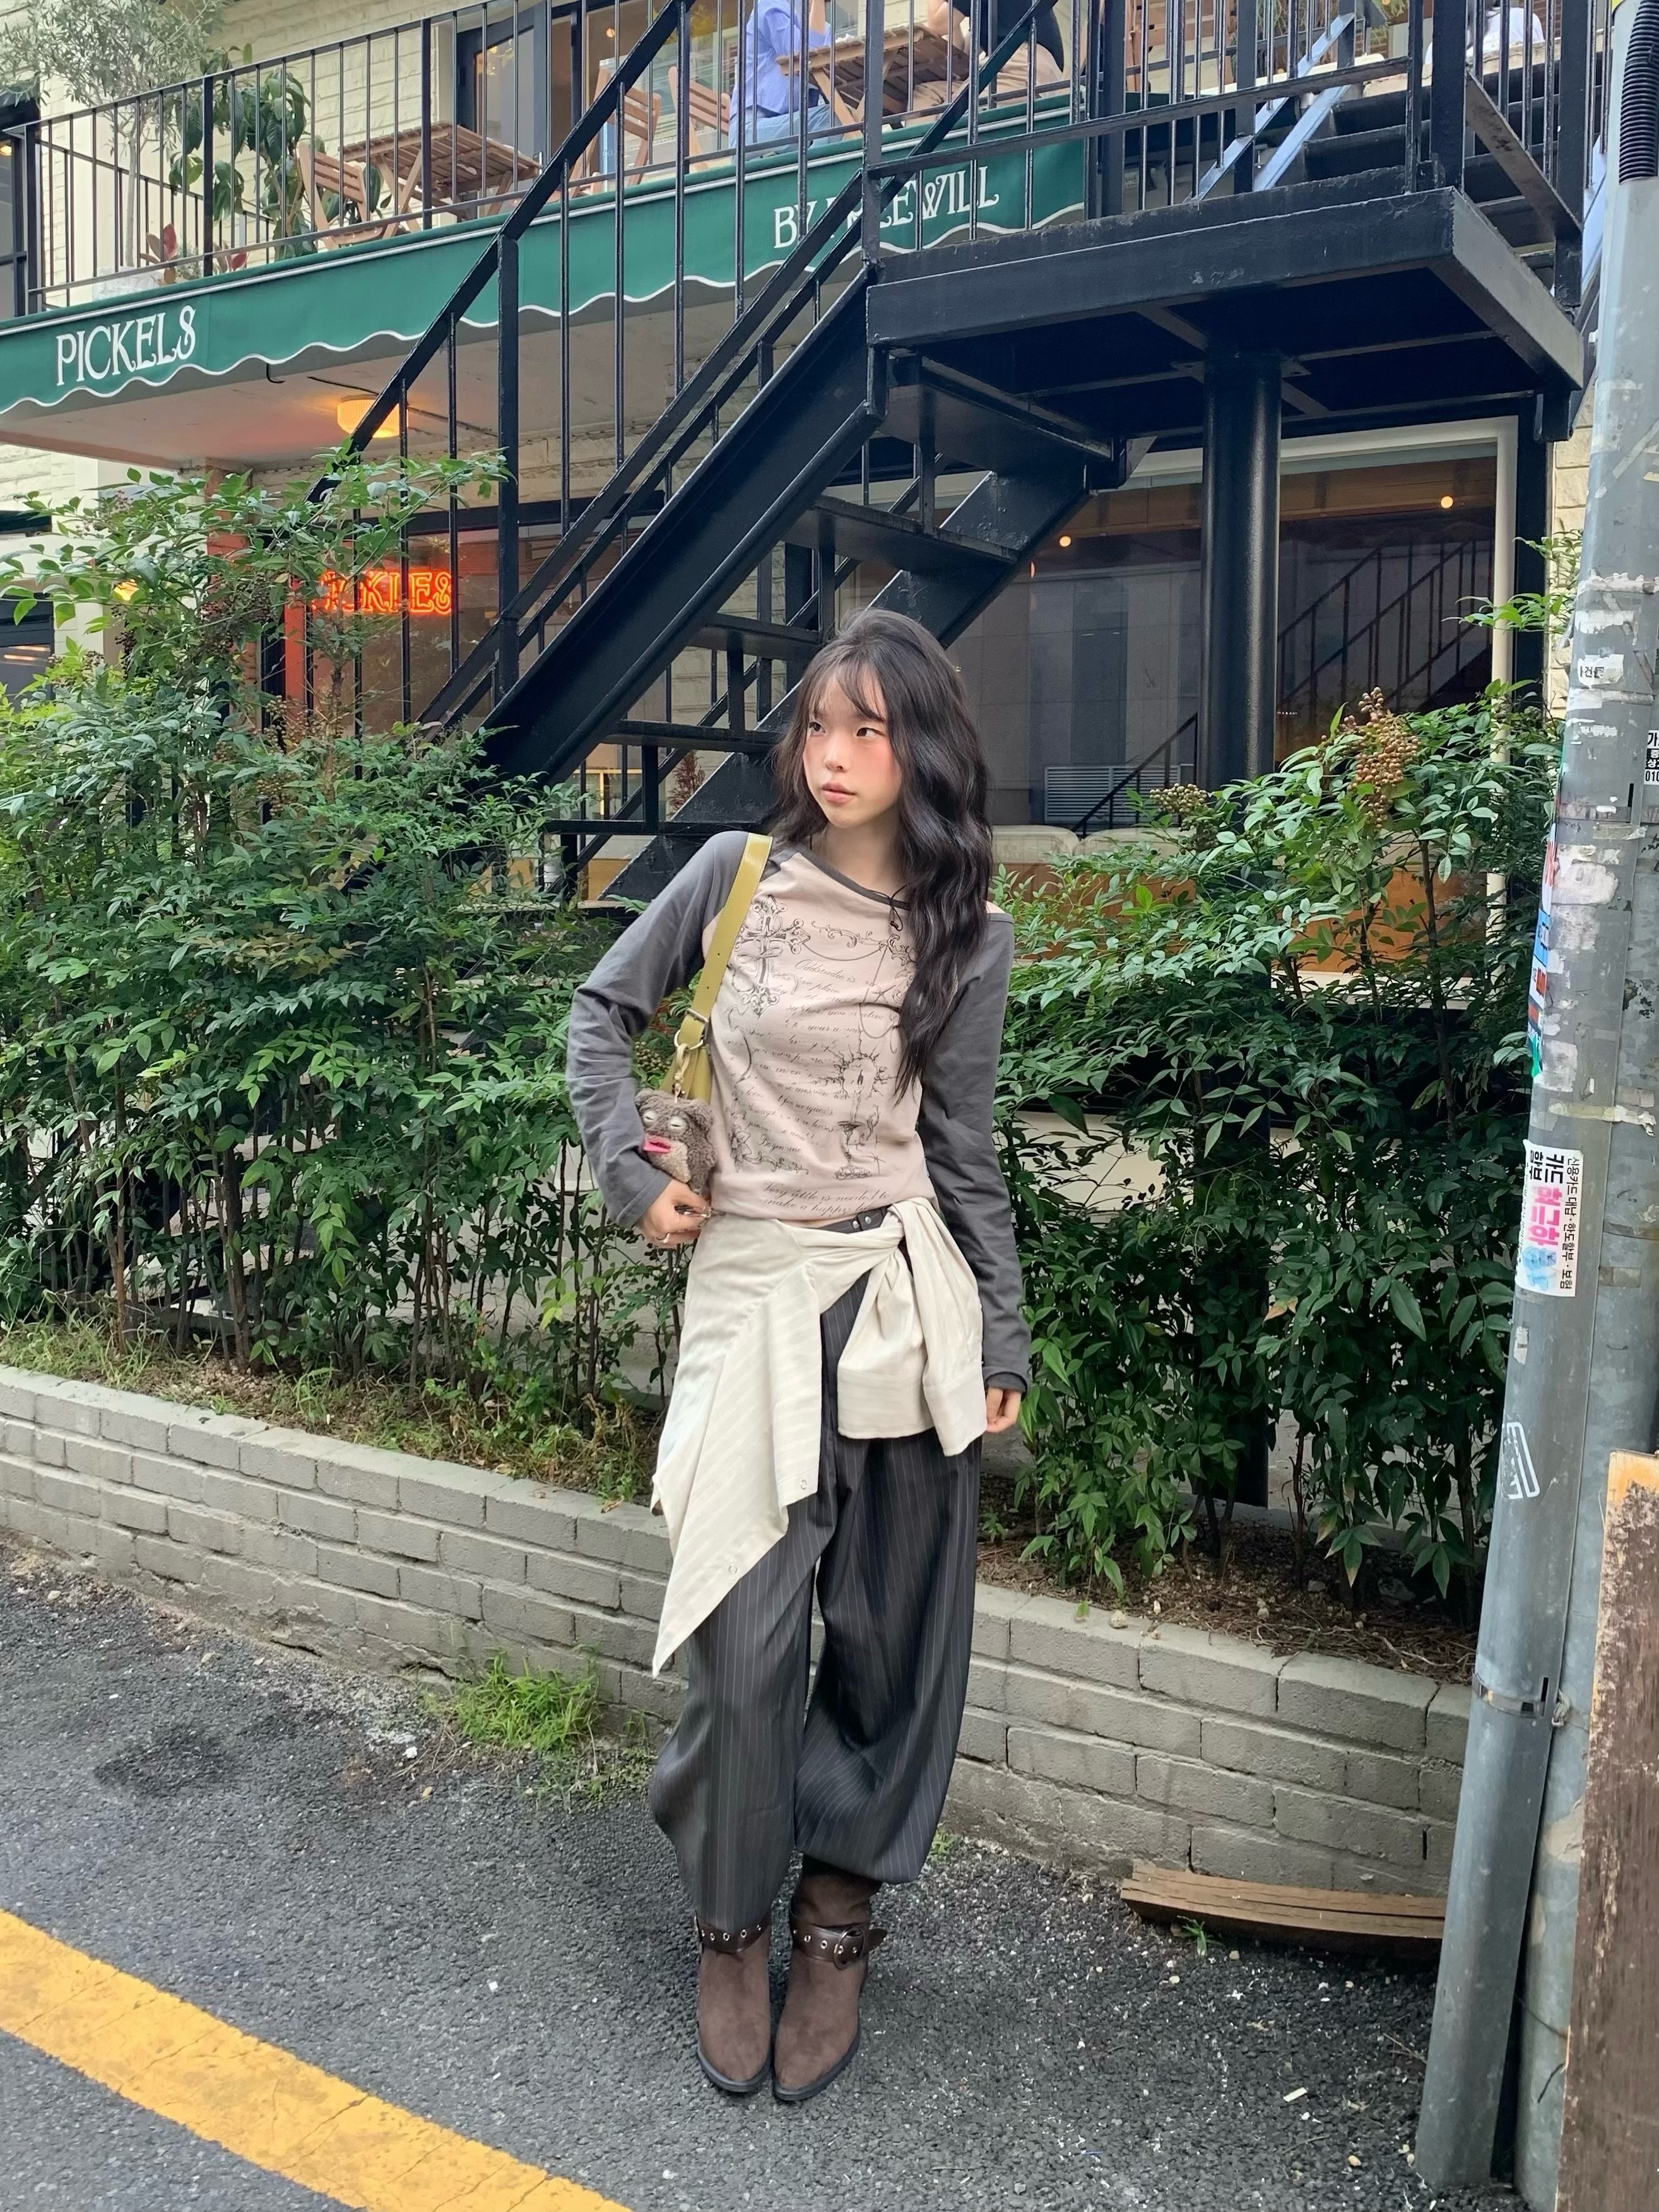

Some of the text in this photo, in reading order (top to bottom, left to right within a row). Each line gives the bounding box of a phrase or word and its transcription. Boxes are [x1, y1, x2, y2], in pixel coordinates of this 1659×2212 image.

[774, 165, 1000, 249] BY EWILL
[56, 305, 196, 385] PICKELS
[795, 959, 845, 979] Oddstudio
[1544, 1154, 1564, 1184] 카드
[1566, 1157, 1580, 1194] 신용카드
[1564, 1197, 1578, 1216] 대납
[1562, 1223, 1576, 1262] 한도할부
